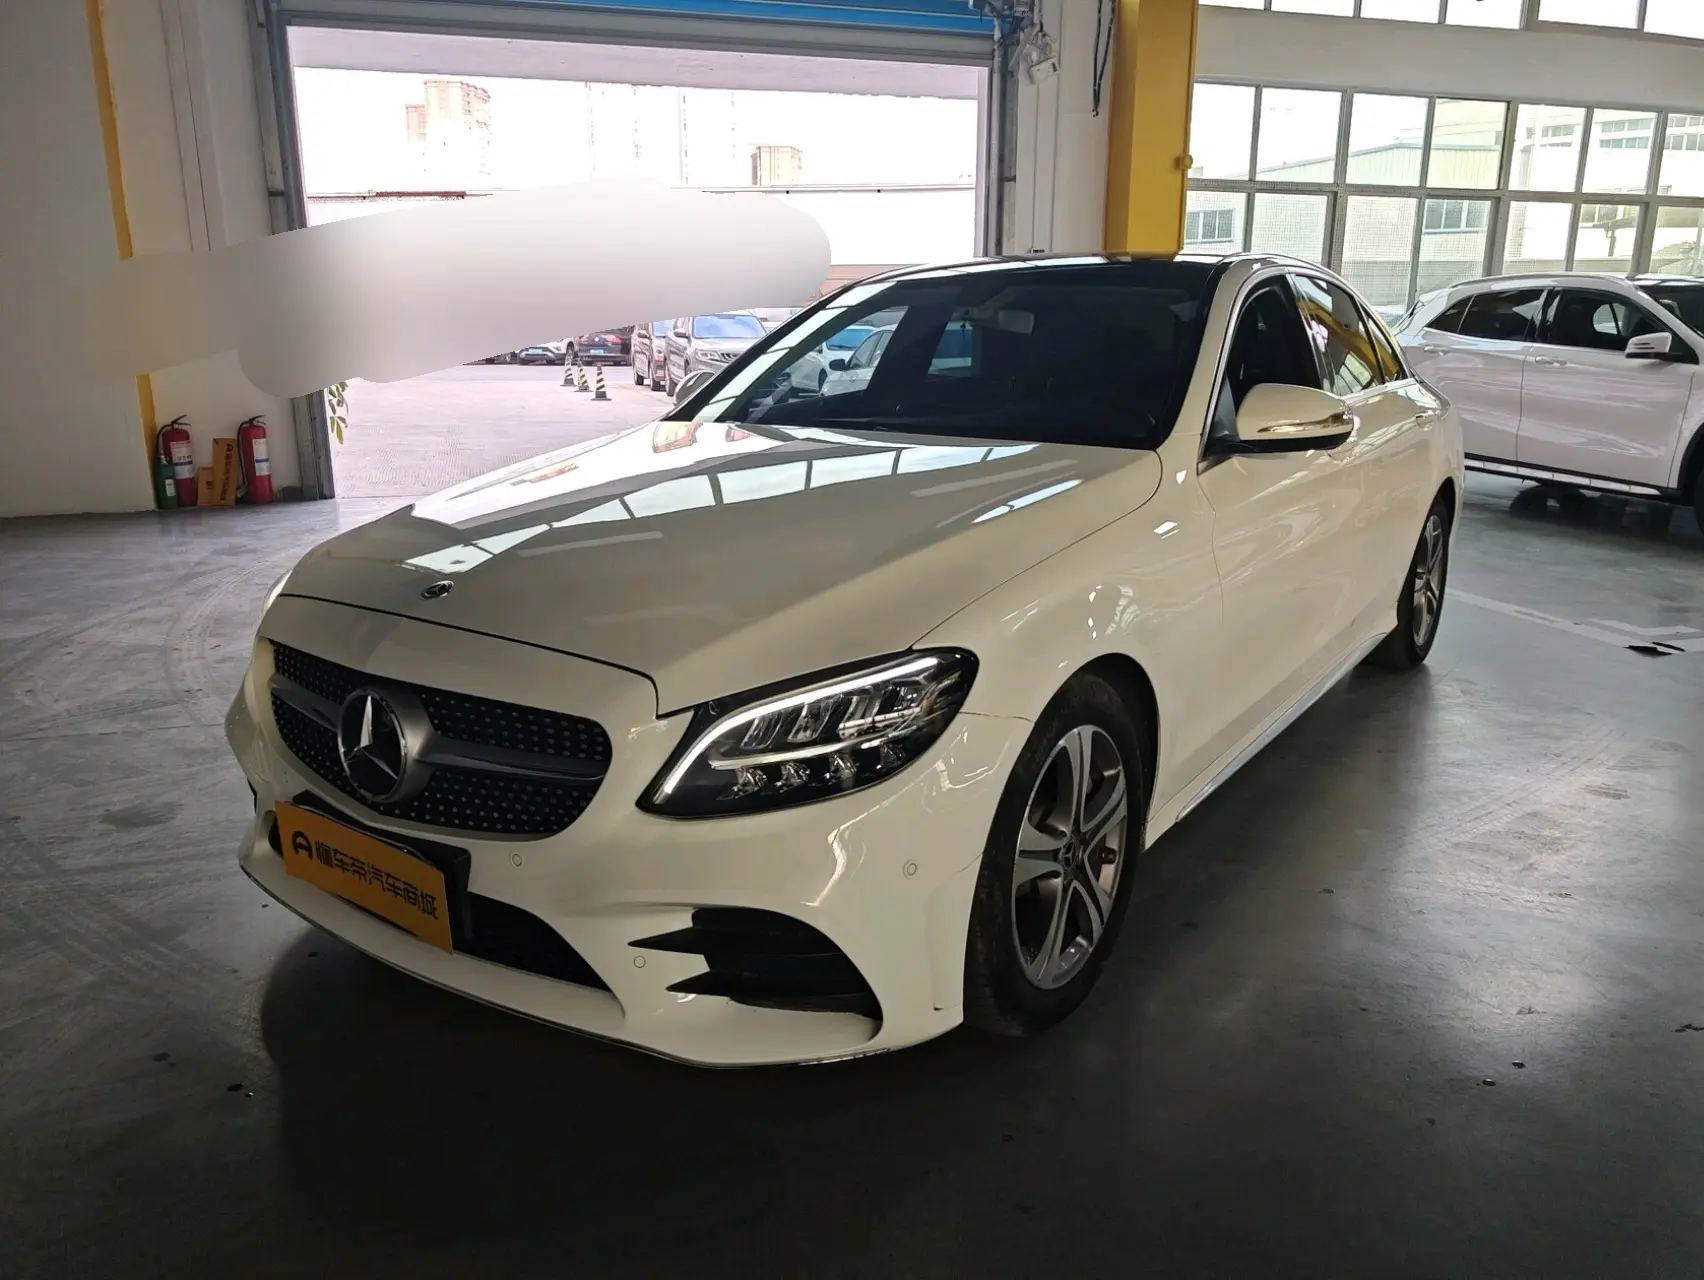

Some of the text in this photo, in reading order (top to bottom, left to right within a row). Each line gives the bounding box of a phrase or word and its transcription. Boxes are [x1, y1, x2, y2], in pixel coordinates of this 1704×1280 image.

[315, 840, 438, 920] 懂车帝汽车商城
